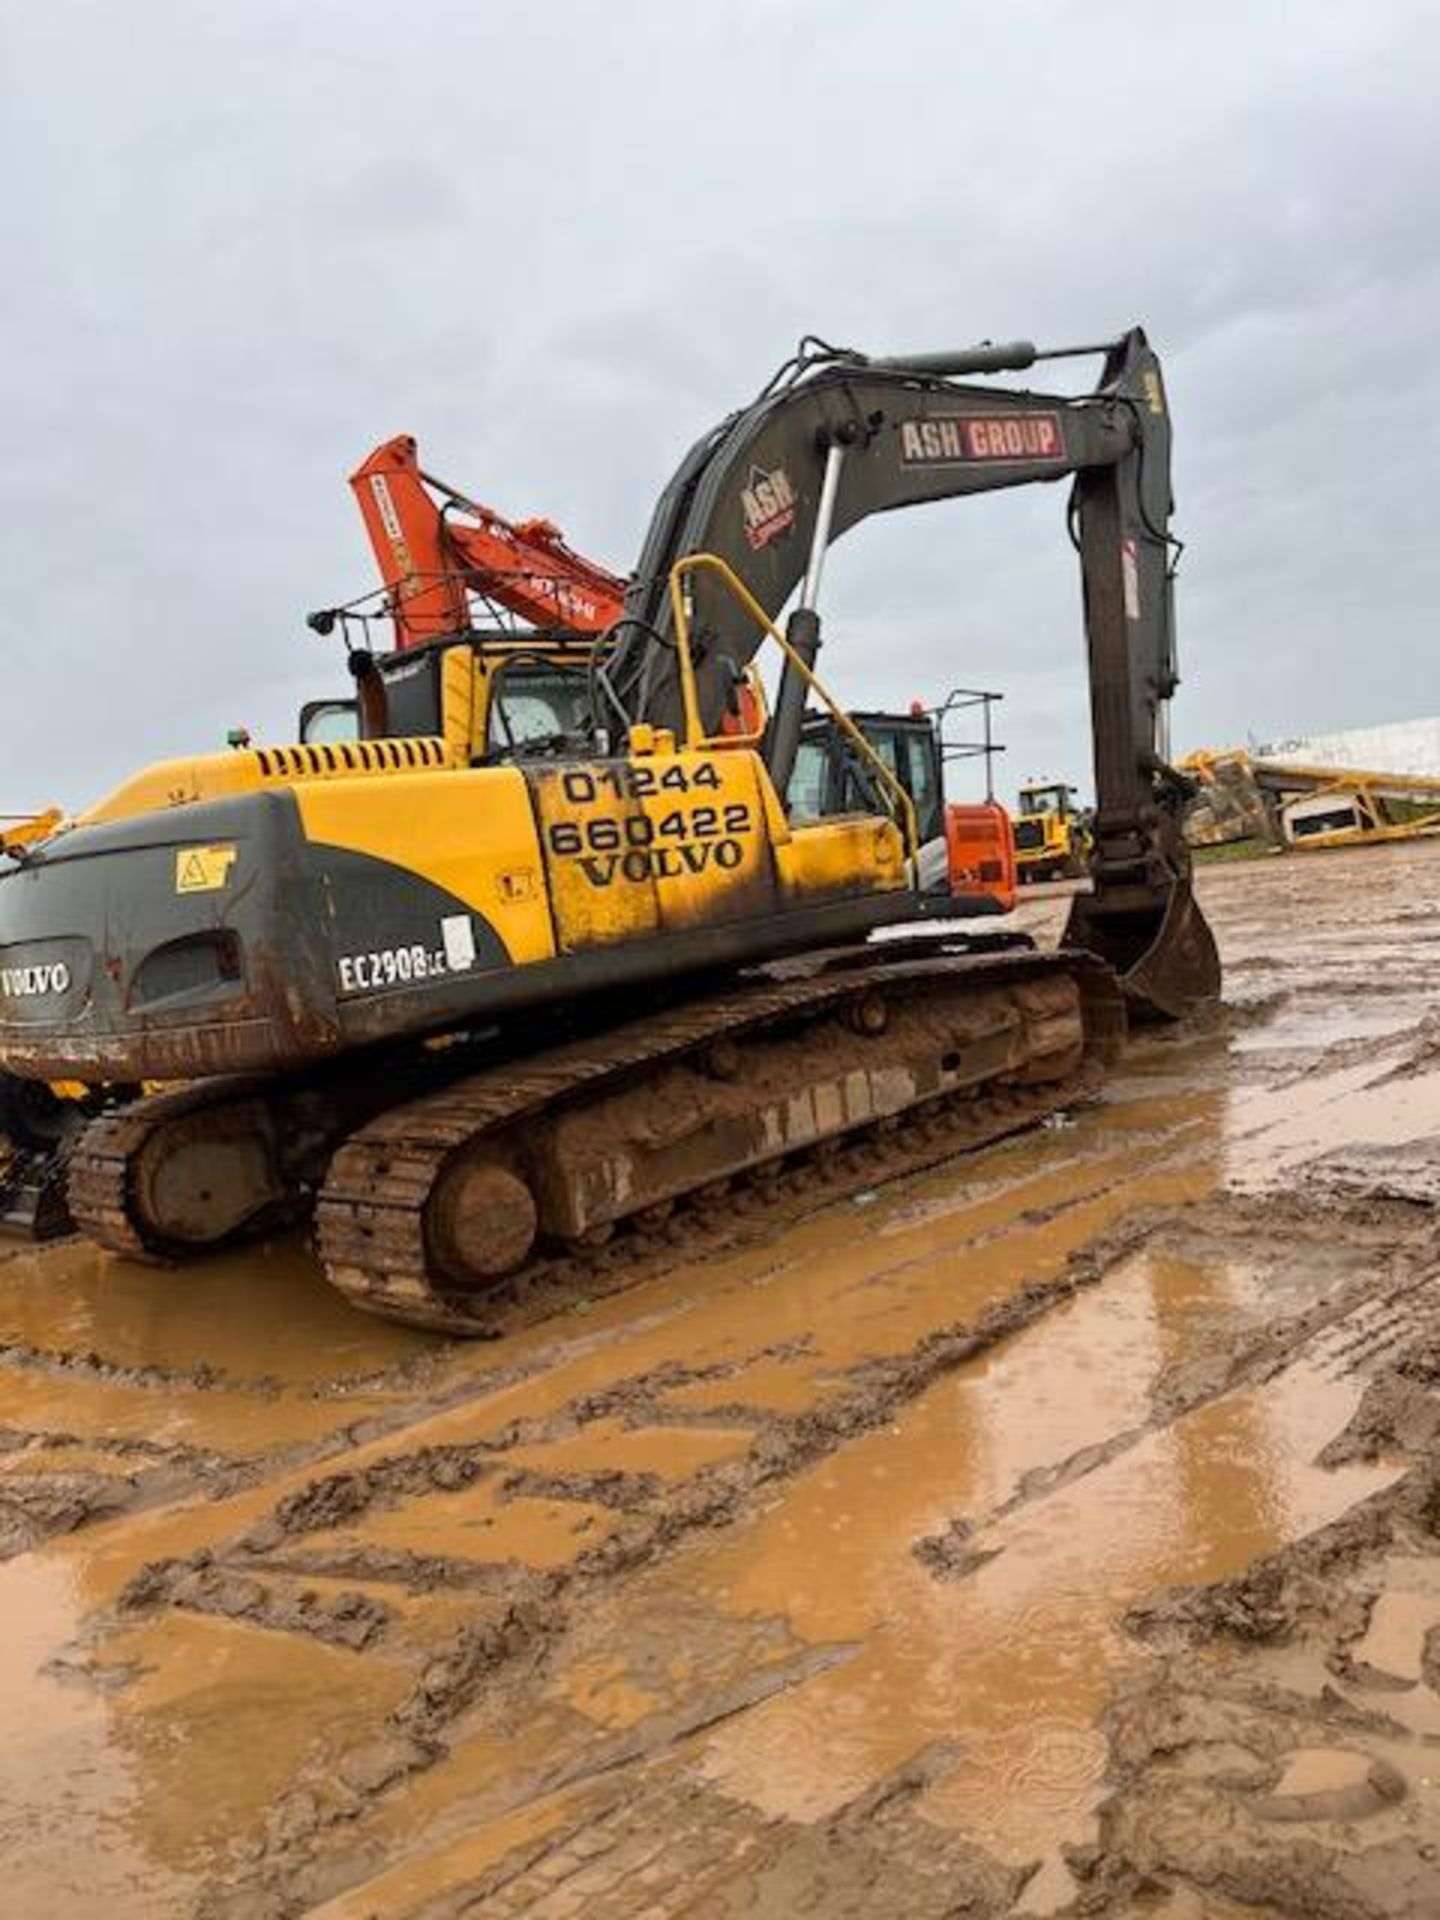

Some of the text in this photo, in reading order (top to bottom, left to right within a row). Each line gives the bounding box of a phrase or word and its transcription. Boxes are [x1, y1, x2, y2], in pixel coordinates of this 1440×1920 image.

[902, 420, 1055, 459] ASH GROUP
[741, 470, 793, 528] ASH
[563, 763, 721, 803] 01244
[551, 804, 751, 854] 660422
[575, 839, 743, 887] VOLVO
[2, 962, 69, 997] VOLVO
